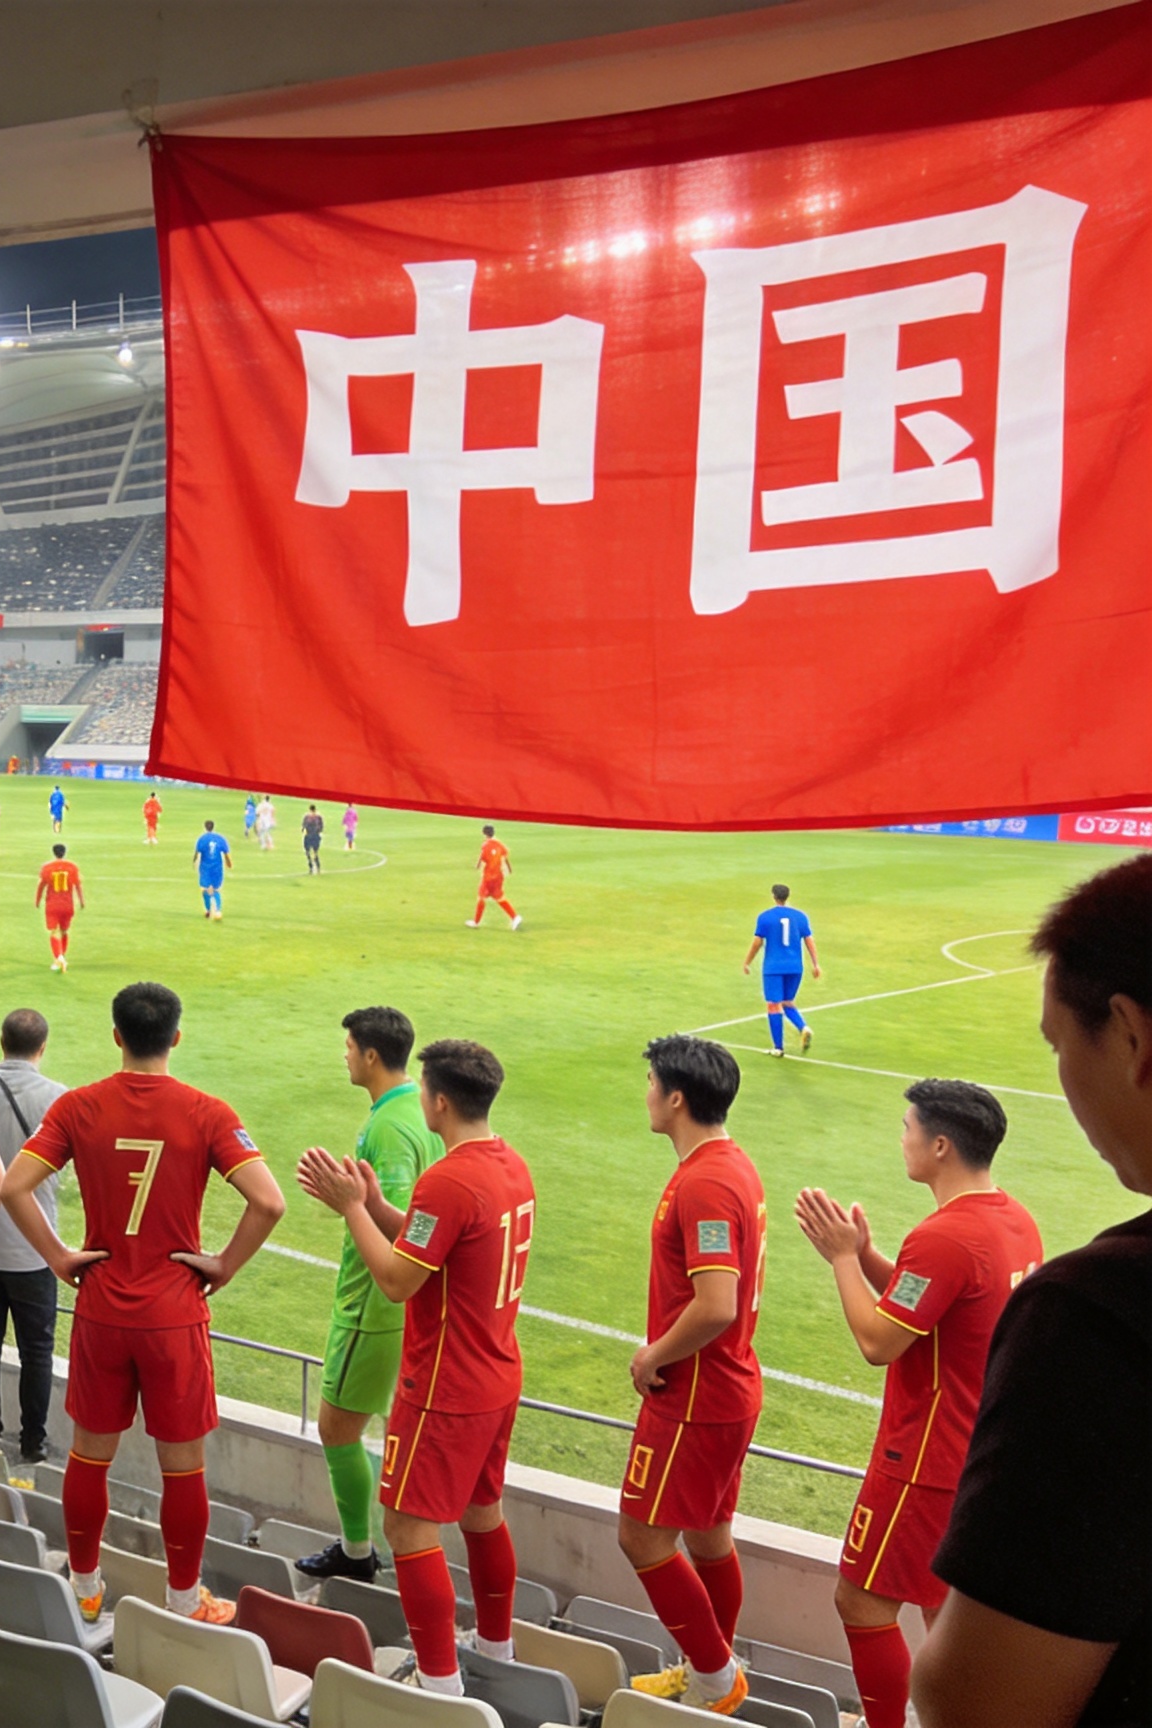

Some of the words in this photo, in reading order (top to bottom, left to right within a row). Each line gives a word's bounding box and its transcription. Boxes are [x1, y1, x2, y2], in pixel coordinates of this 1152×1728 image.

[294, 184, 1088, 627] 中国
[780, 917, 790, 946] 1
[115, 1137, 165, 1236] 7
